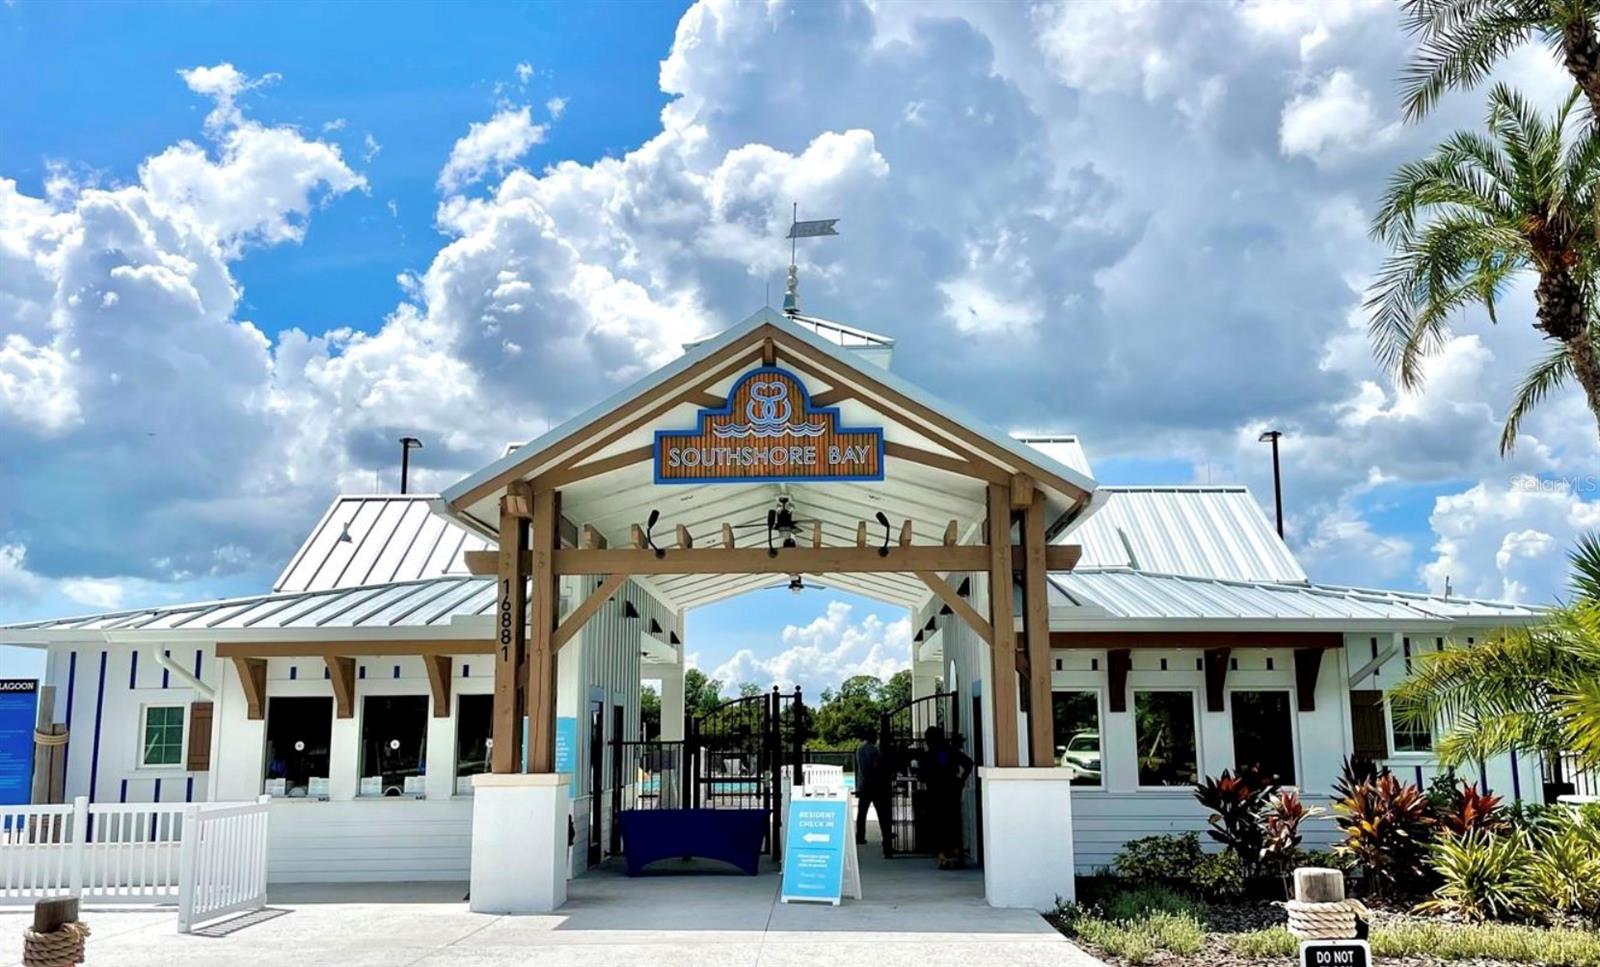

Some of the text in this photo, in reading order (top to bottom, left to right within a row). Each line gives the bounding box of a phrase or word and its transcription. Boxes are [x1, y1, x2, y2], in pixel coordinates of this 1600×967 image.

[669, 445, 870, 467] SOUTHSHORE BAY
[501, 578, 512, 662] 16881
[799, 811, 836, 819] RESIDENT
[1316, 950, 1354, 964] DO NOT
